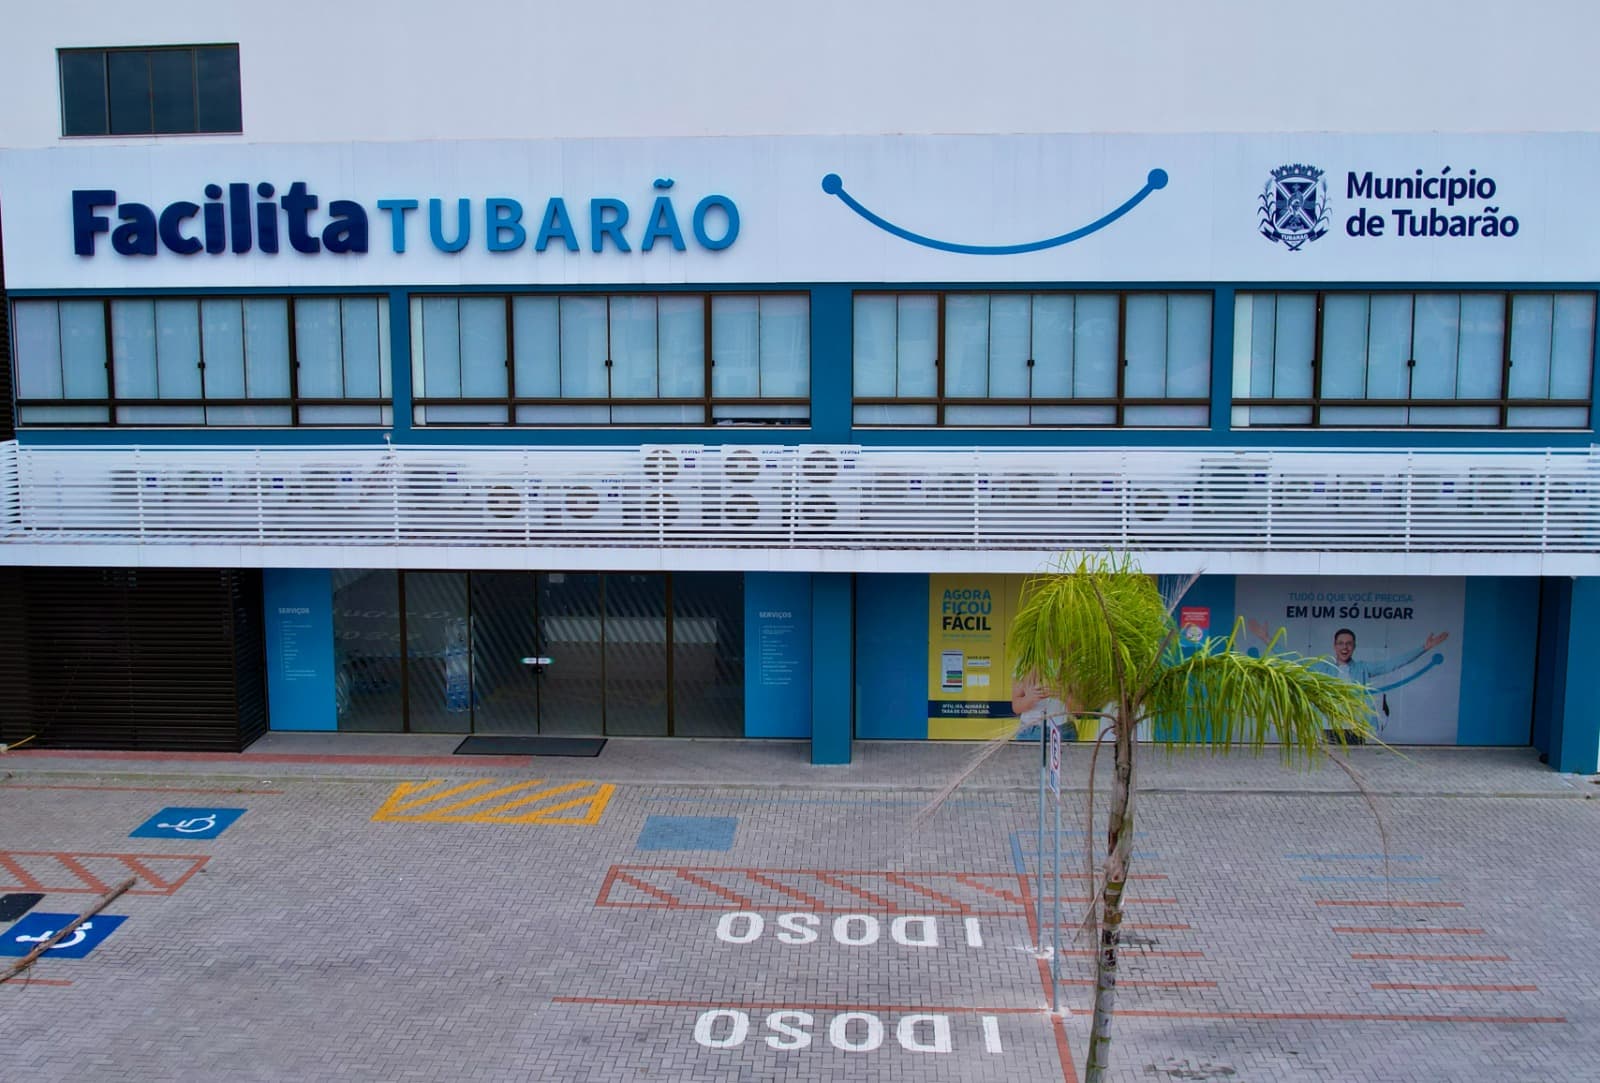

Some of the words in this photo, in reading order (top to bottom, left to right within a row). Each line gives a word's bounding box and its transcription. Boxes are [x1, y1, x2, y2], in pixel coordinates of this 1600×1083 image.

[1347, 165, 1497, 206] Município
[72, 182, 369, 256] Facilita
[377, 178, 740, 253] TUBARÃO
[1346, 208, 1385, 237] de
[1392, 206, 1520, 237] Tubarão
[943, 588, 992, 600] AGORA
[1288, 591, 1315, 601] TUDO
[1316, 592, 1324, 601] O
[1326, 592, 1346, 603] QUE
[1348, 590, 1373, 602] VOCÊ
[1375, 593, 1413, 603] PRECISA
[759, 611, 792, 620] SERVIÇOS
[942, 600, 992, 615] FICOU
[1286, 605, 1308, 618] EM
[1311, 606, 1335, 619] UM
[1339, 603, 1360, 619] SÓ
[1363, 606, 1414, 620] LUGAR
[942, 612, 992, 631] FÁCIL
[716, 911, 982, 948] IDOSO
[694, 1009, 1003, 1053] IDOSO
